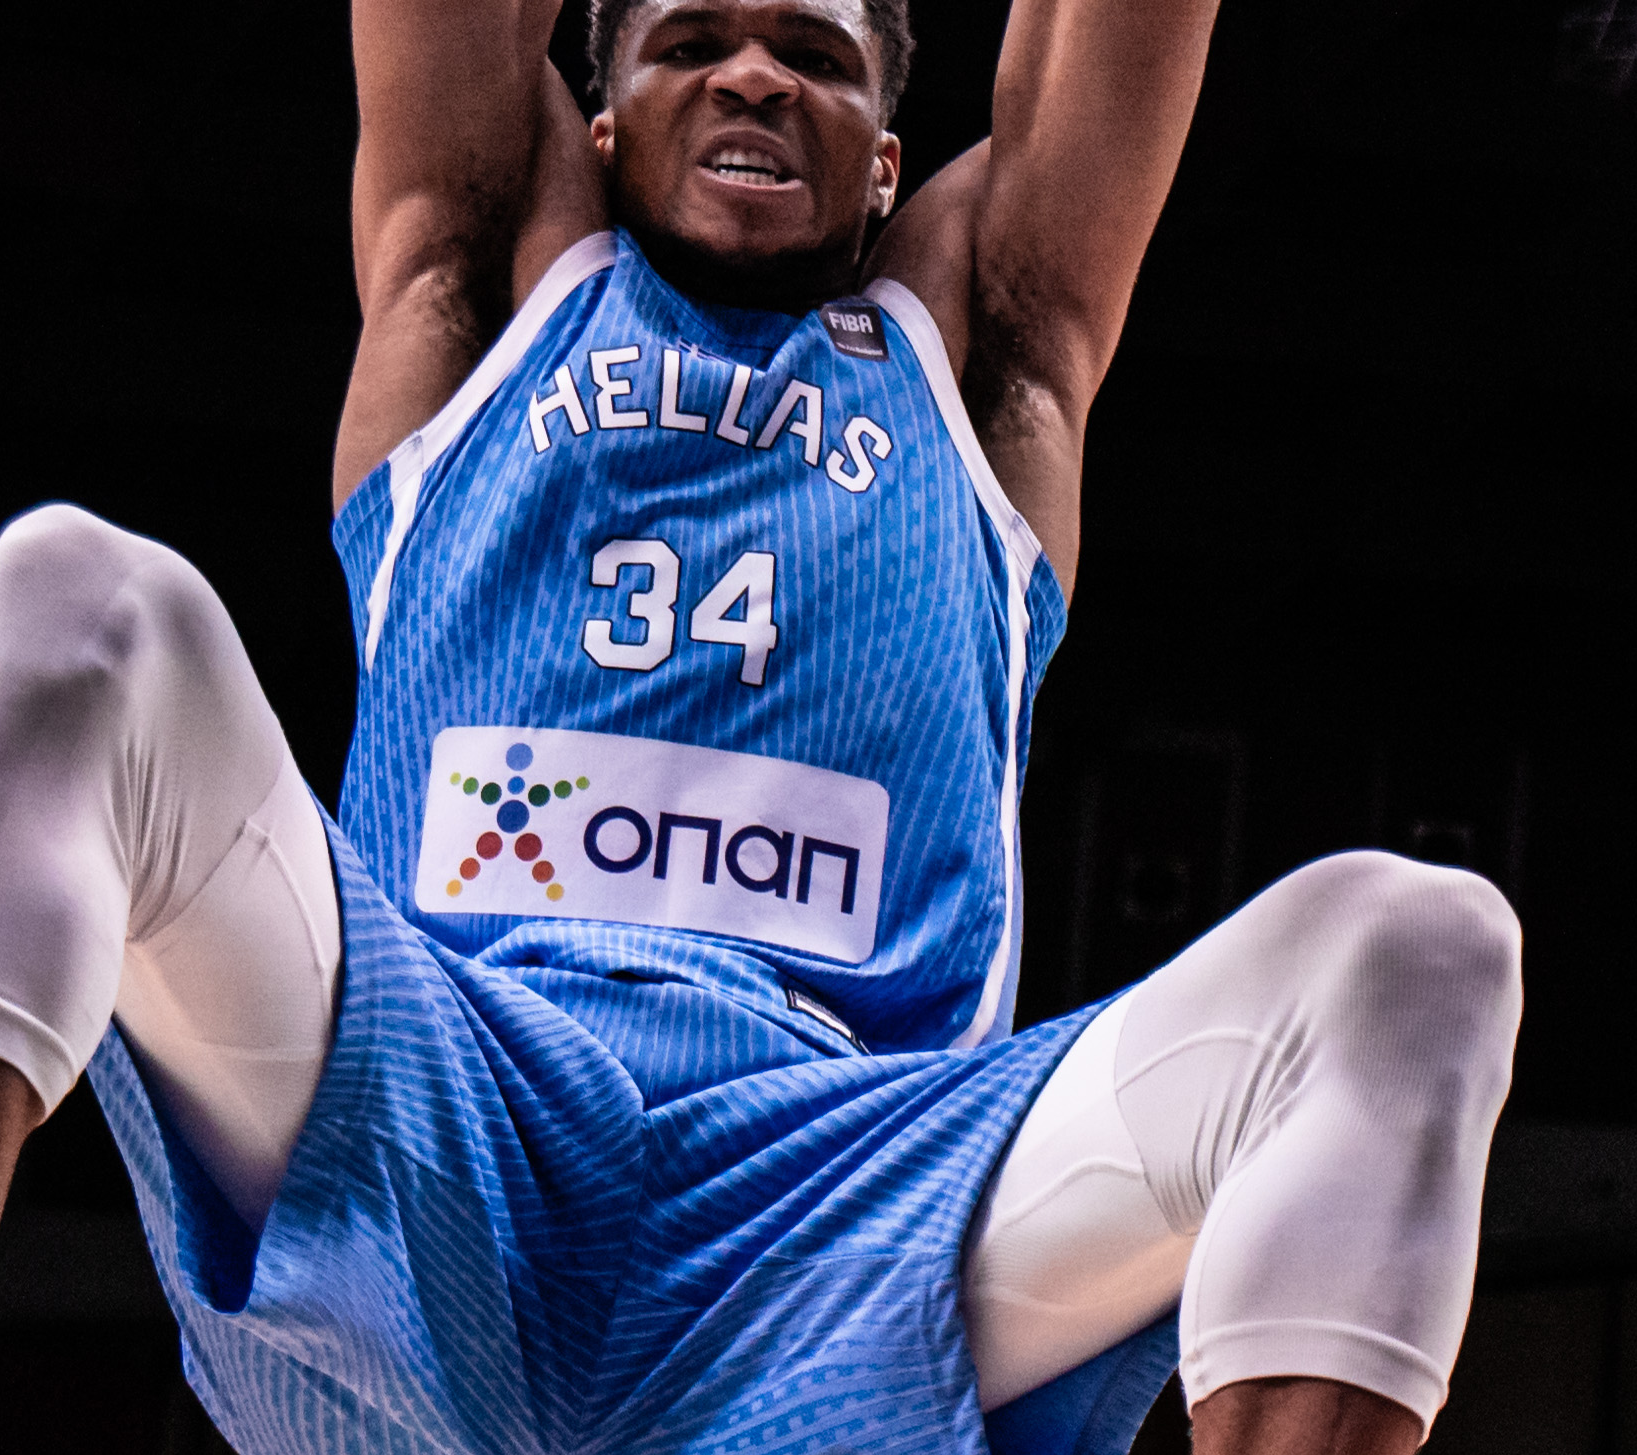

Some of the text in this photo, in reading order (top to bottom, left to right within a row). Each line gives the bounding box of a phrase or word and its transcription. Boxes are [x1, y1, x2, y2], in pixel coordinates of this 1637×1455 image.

[828, 311, 874, 334] FIBA
[527, 344, 893, 494] HELLAS
[582, 538, 779, 687] 34
